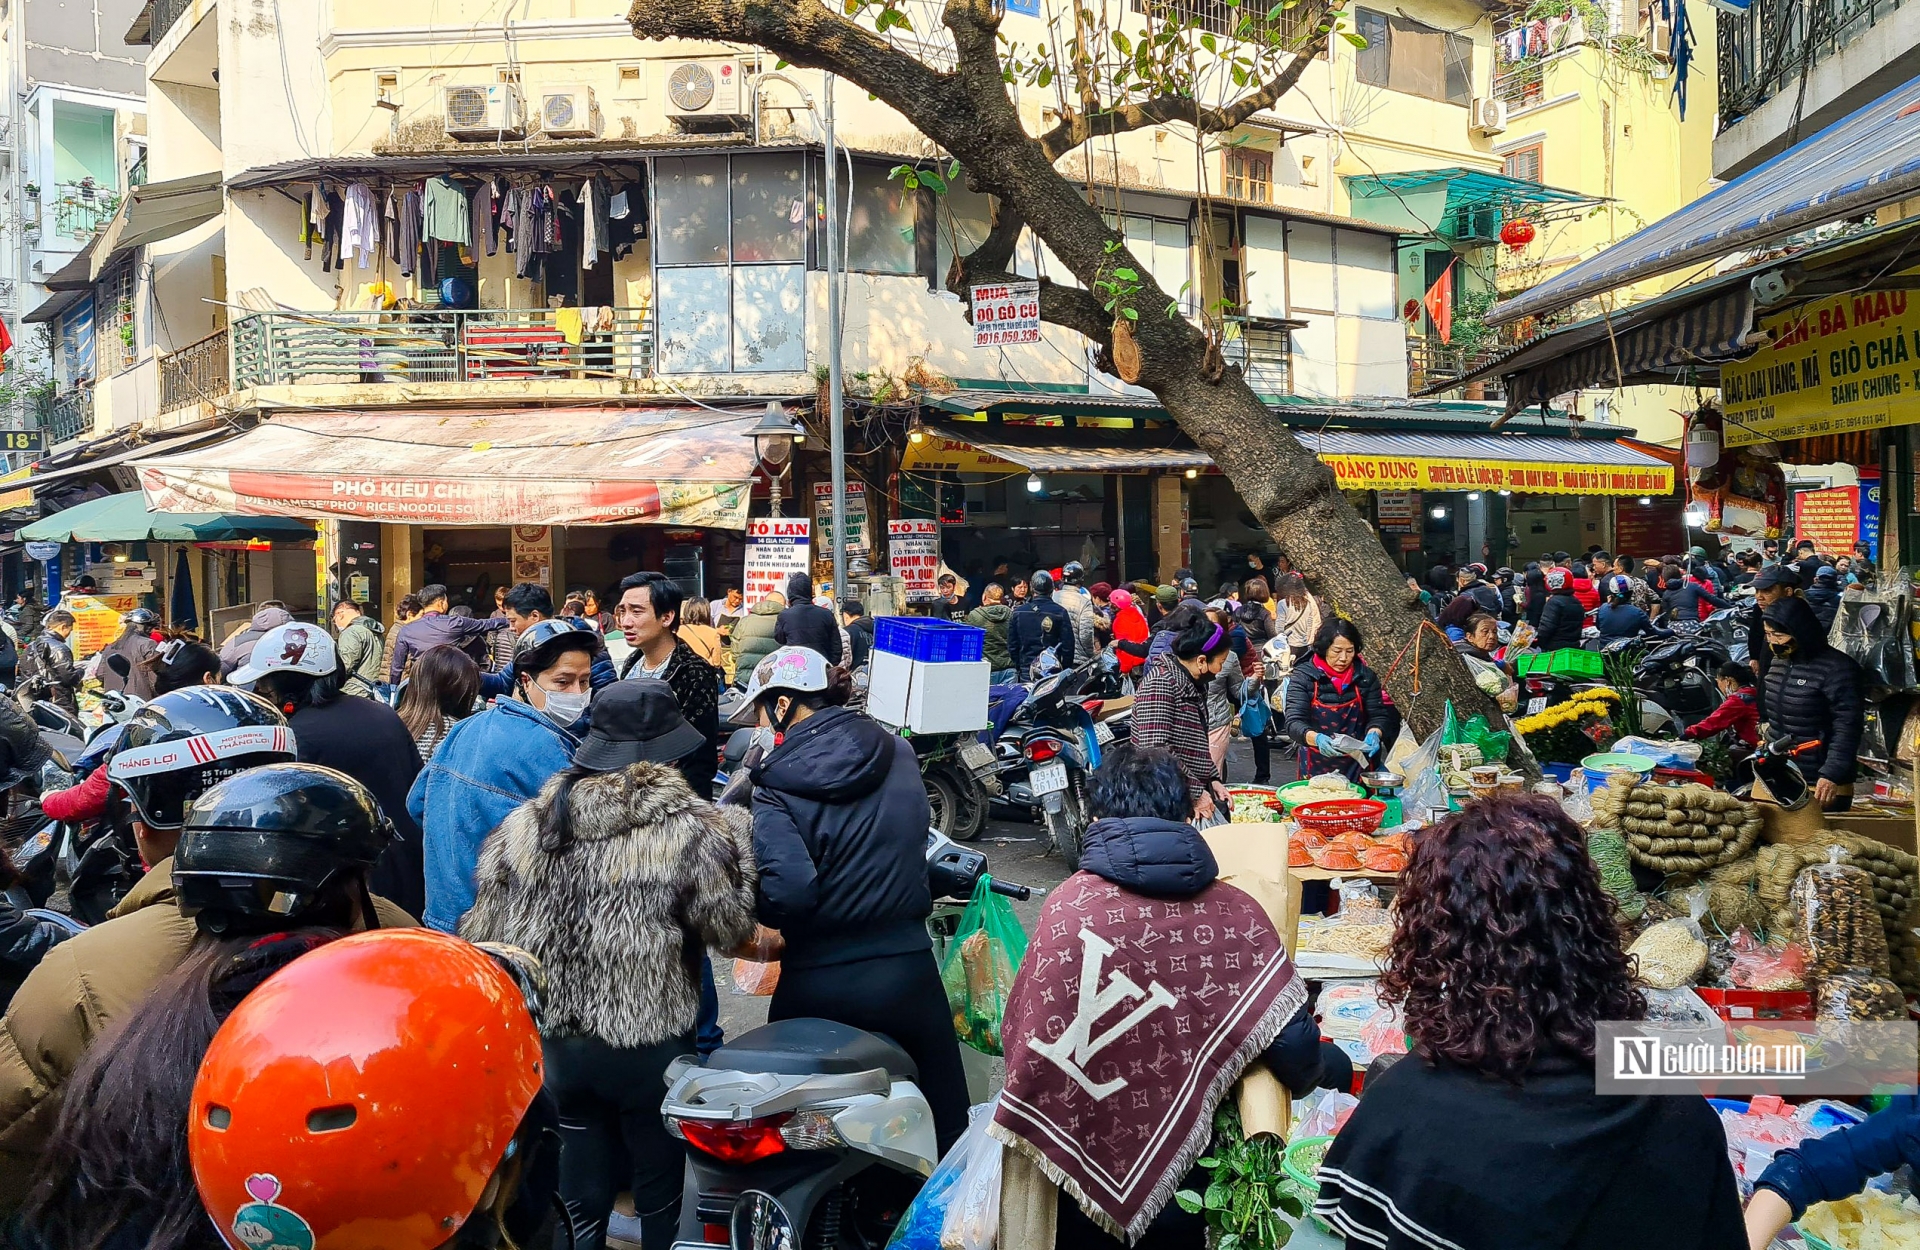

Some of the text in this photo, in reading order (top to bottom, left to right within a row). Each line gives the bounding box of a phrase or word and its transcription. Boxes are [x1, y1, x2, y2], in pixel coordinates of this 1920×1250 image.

[721, 78, 732, 86] LG
[974, 286, 1009, 301] MUA
[1020, 301, 1038, 319] CŨ
[1829, 340, 1861, 378] GIÒ
[1865, 326, 1909, 370] CHẢ
[1724, 371, 1743, 405] CÁC
[1745, 366, 1766, 405] LOẠI
[1768, 360, 1800, 396] VÀNG,
[1831, 380, 1859, 405] BÁNH
[1378, 461, 1419, 479] DUNG
[332, 477, 376, 496] PHỞ
[366, 501, 395, 512] RICE
[398, 502, 453, 513] NOODLE
[588, 506, 644, 516] CHICKEN
[713, 509, 737, 518] Chanh
[748, 519, 769, 535] TỐ
[774, 523, 808, 535] LAN
[890, 520, 937, 533] TỐ LAN
[892, 556, 921, 568] CHIM
[746, 570, 765, 579] CHIM
[768, 570, 785, 581] QUAY
[901, 568, 915, 580] GÀ
[758, 583, 775, 593] QUAY
[115, 597, 133, 608] 14
[221, 732, 264, 744] MOTORBIKE
[118, 753, 177, 770] THẮNG LỢI
[202, 770, 212, 778] 25
[1035, 767, 1060, 783] 29-K1
[1034, 776, 1066, 794] 361.16
